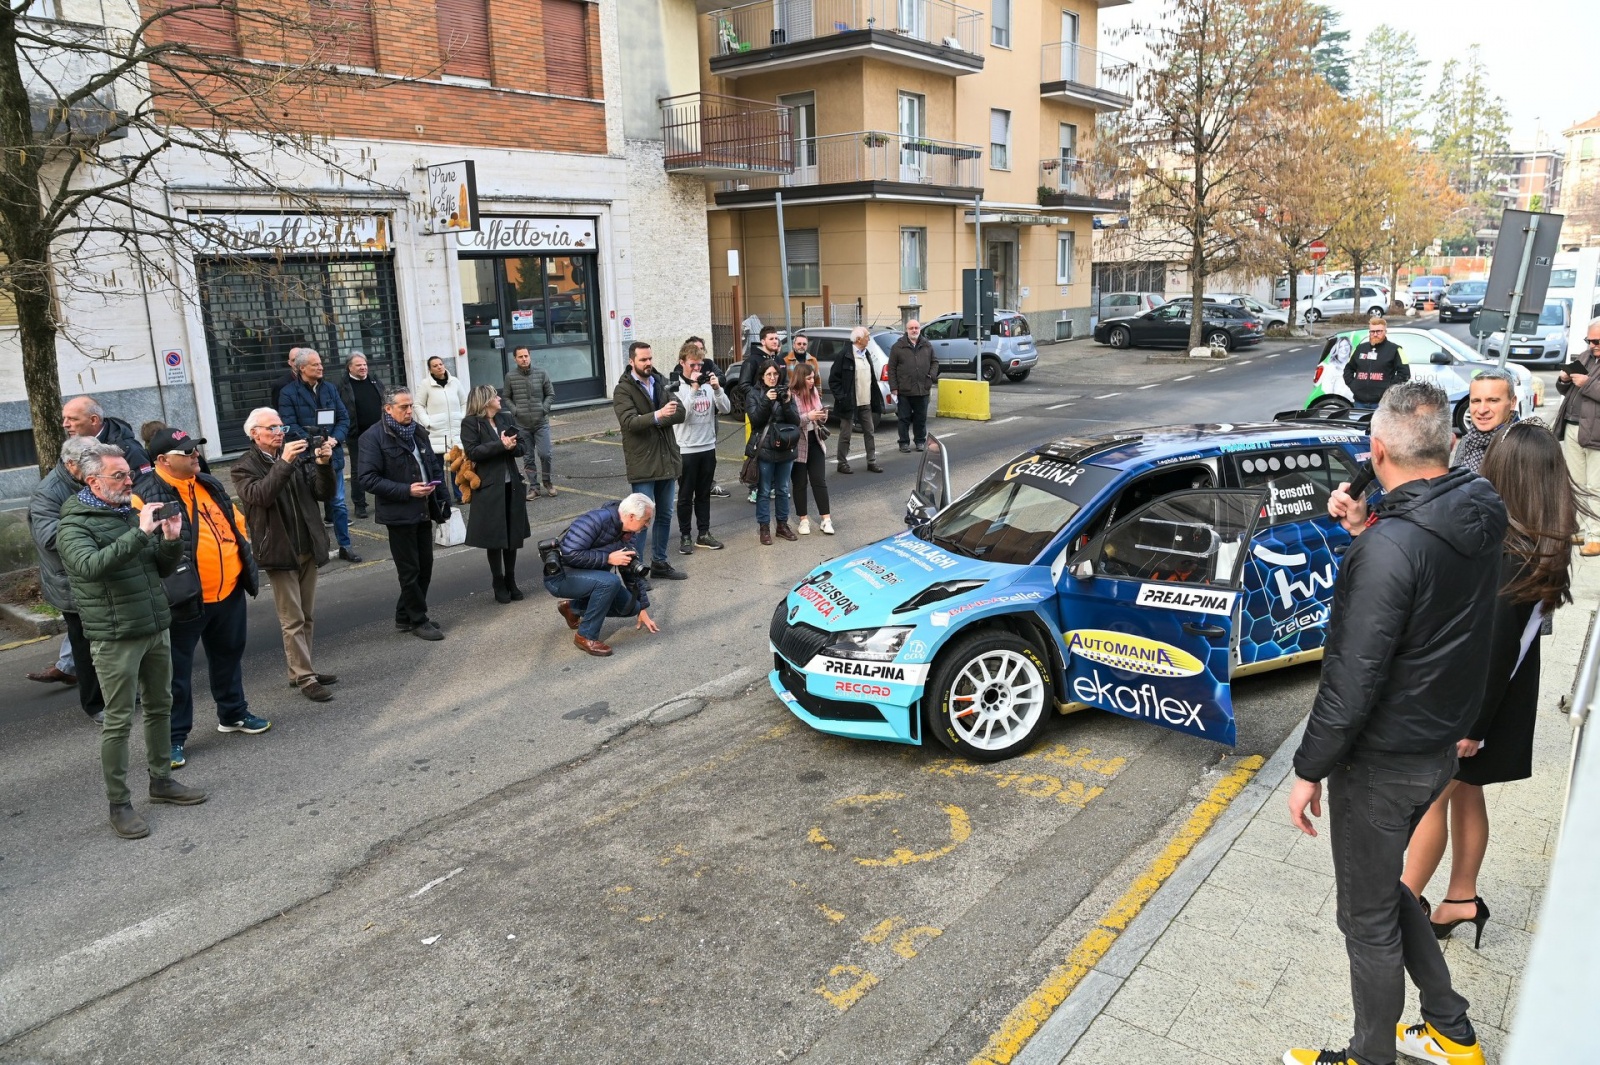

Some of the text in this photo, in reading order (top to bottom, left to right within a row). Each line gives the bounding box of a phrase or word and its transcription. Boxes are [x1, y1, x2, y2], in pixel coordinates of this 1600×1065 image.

[431, 166, 457, 184] Pane
[200, 216, 359, 250] Panetteria
[455, 219, 572, 250] Caffetteria
[1015, 463, 1079, 487] CELLINA
[1042, 460, 1086, 475] GRUPPO
[796, 585, 835, 618] ROBOTICA
[1144, 589, 1228, 611] PREALPINA
[826, 660, 905, 681] PREALPINA
[835, 681, 891, 697] RECORD
[1073, 669, 1206, 732] ekaflex
